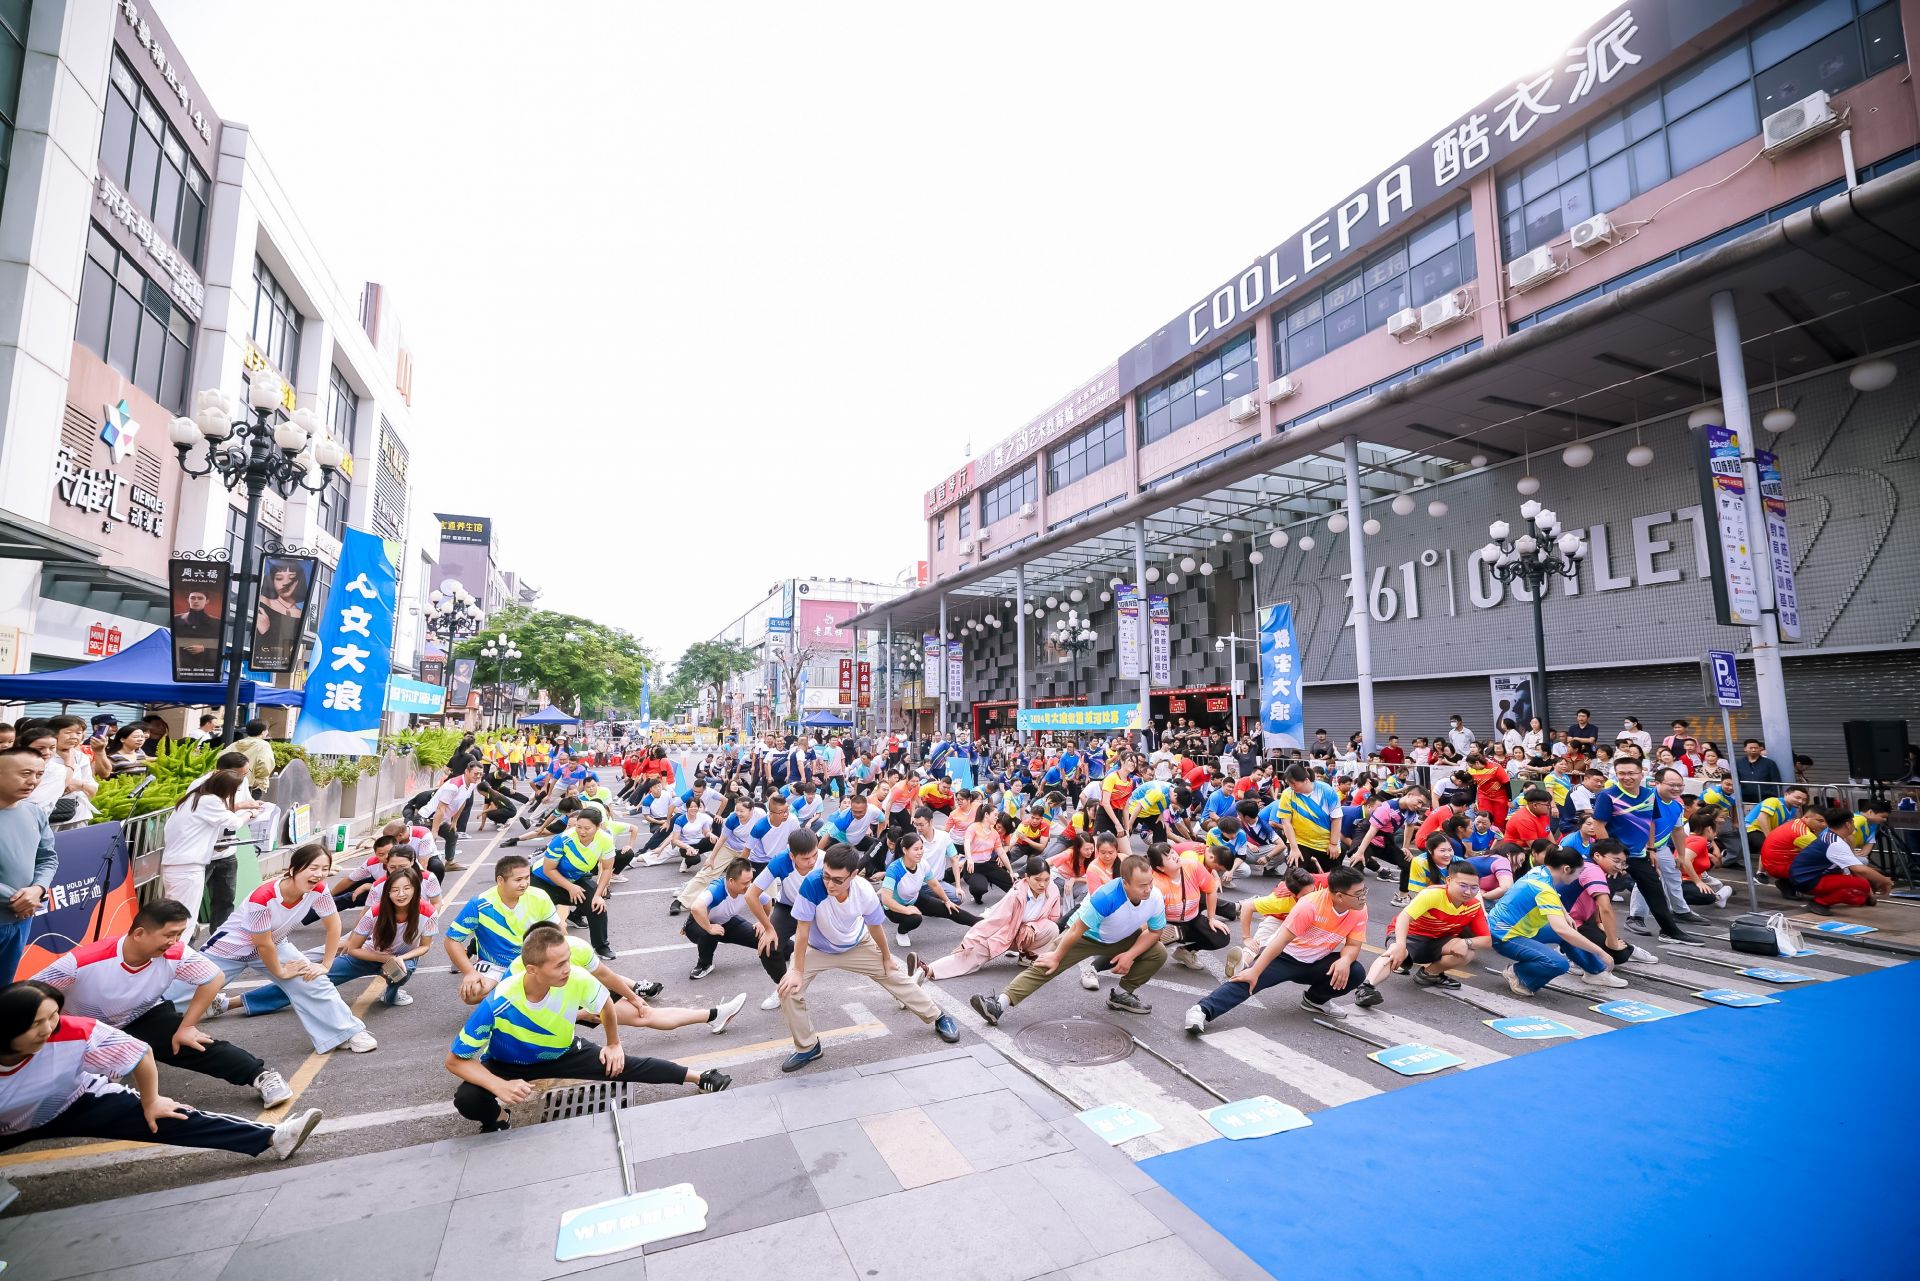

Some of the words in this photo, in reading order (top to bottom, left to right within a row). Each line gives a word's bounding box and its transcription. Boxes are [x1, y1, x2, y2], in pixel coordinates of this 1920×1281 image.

[1431, 8, 1642, 187] 酷衣派
[1188, 163, 1413, 346] COOLEPA
[54, 446, 131, 523] 英雄汇
[132, 485, 167, 515] HEROES
[181, 567, 218, 579] 周六福
[322, 572, 378, 712] 人文大浪
[1714, 658, 1729, 686] P
[66, 881, 83, 891] HOLD
[68, 884, 103, 906] 新天地
